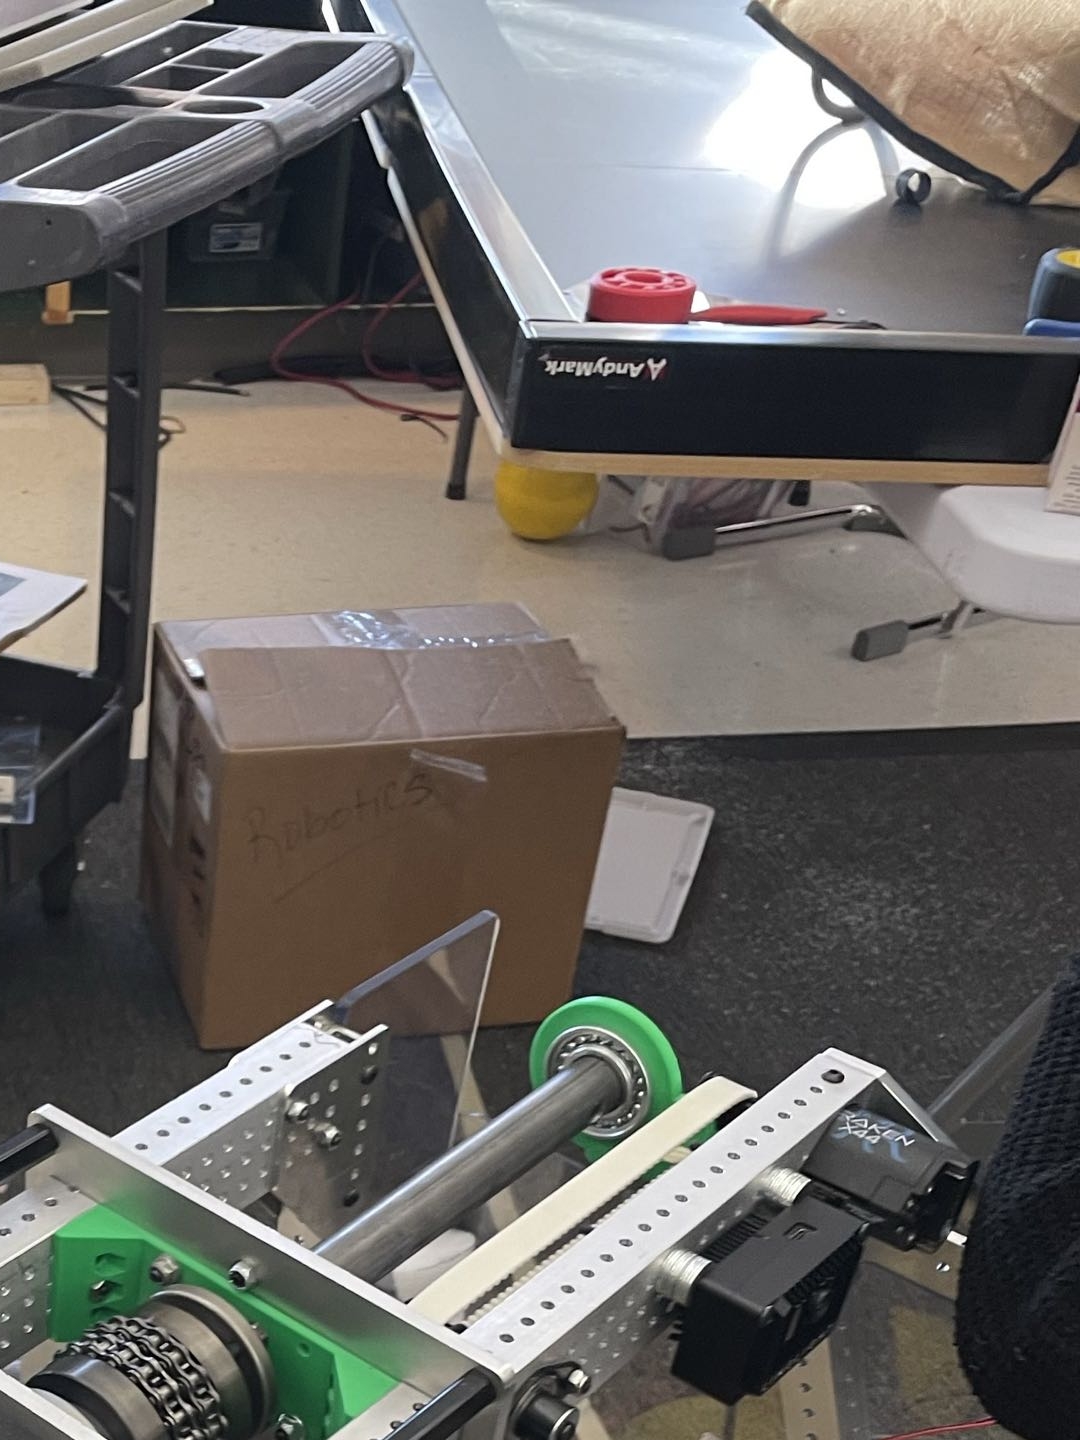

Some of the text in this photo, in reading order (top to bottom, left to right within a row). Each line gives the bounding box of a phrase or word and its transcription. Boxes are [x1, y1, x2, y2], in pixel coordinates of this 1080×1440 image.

[544, 356, 645, 378] AndyMark
[243, 773, 433, 868] Robotics
[841, 1110, 916, 1147] RAKEN
